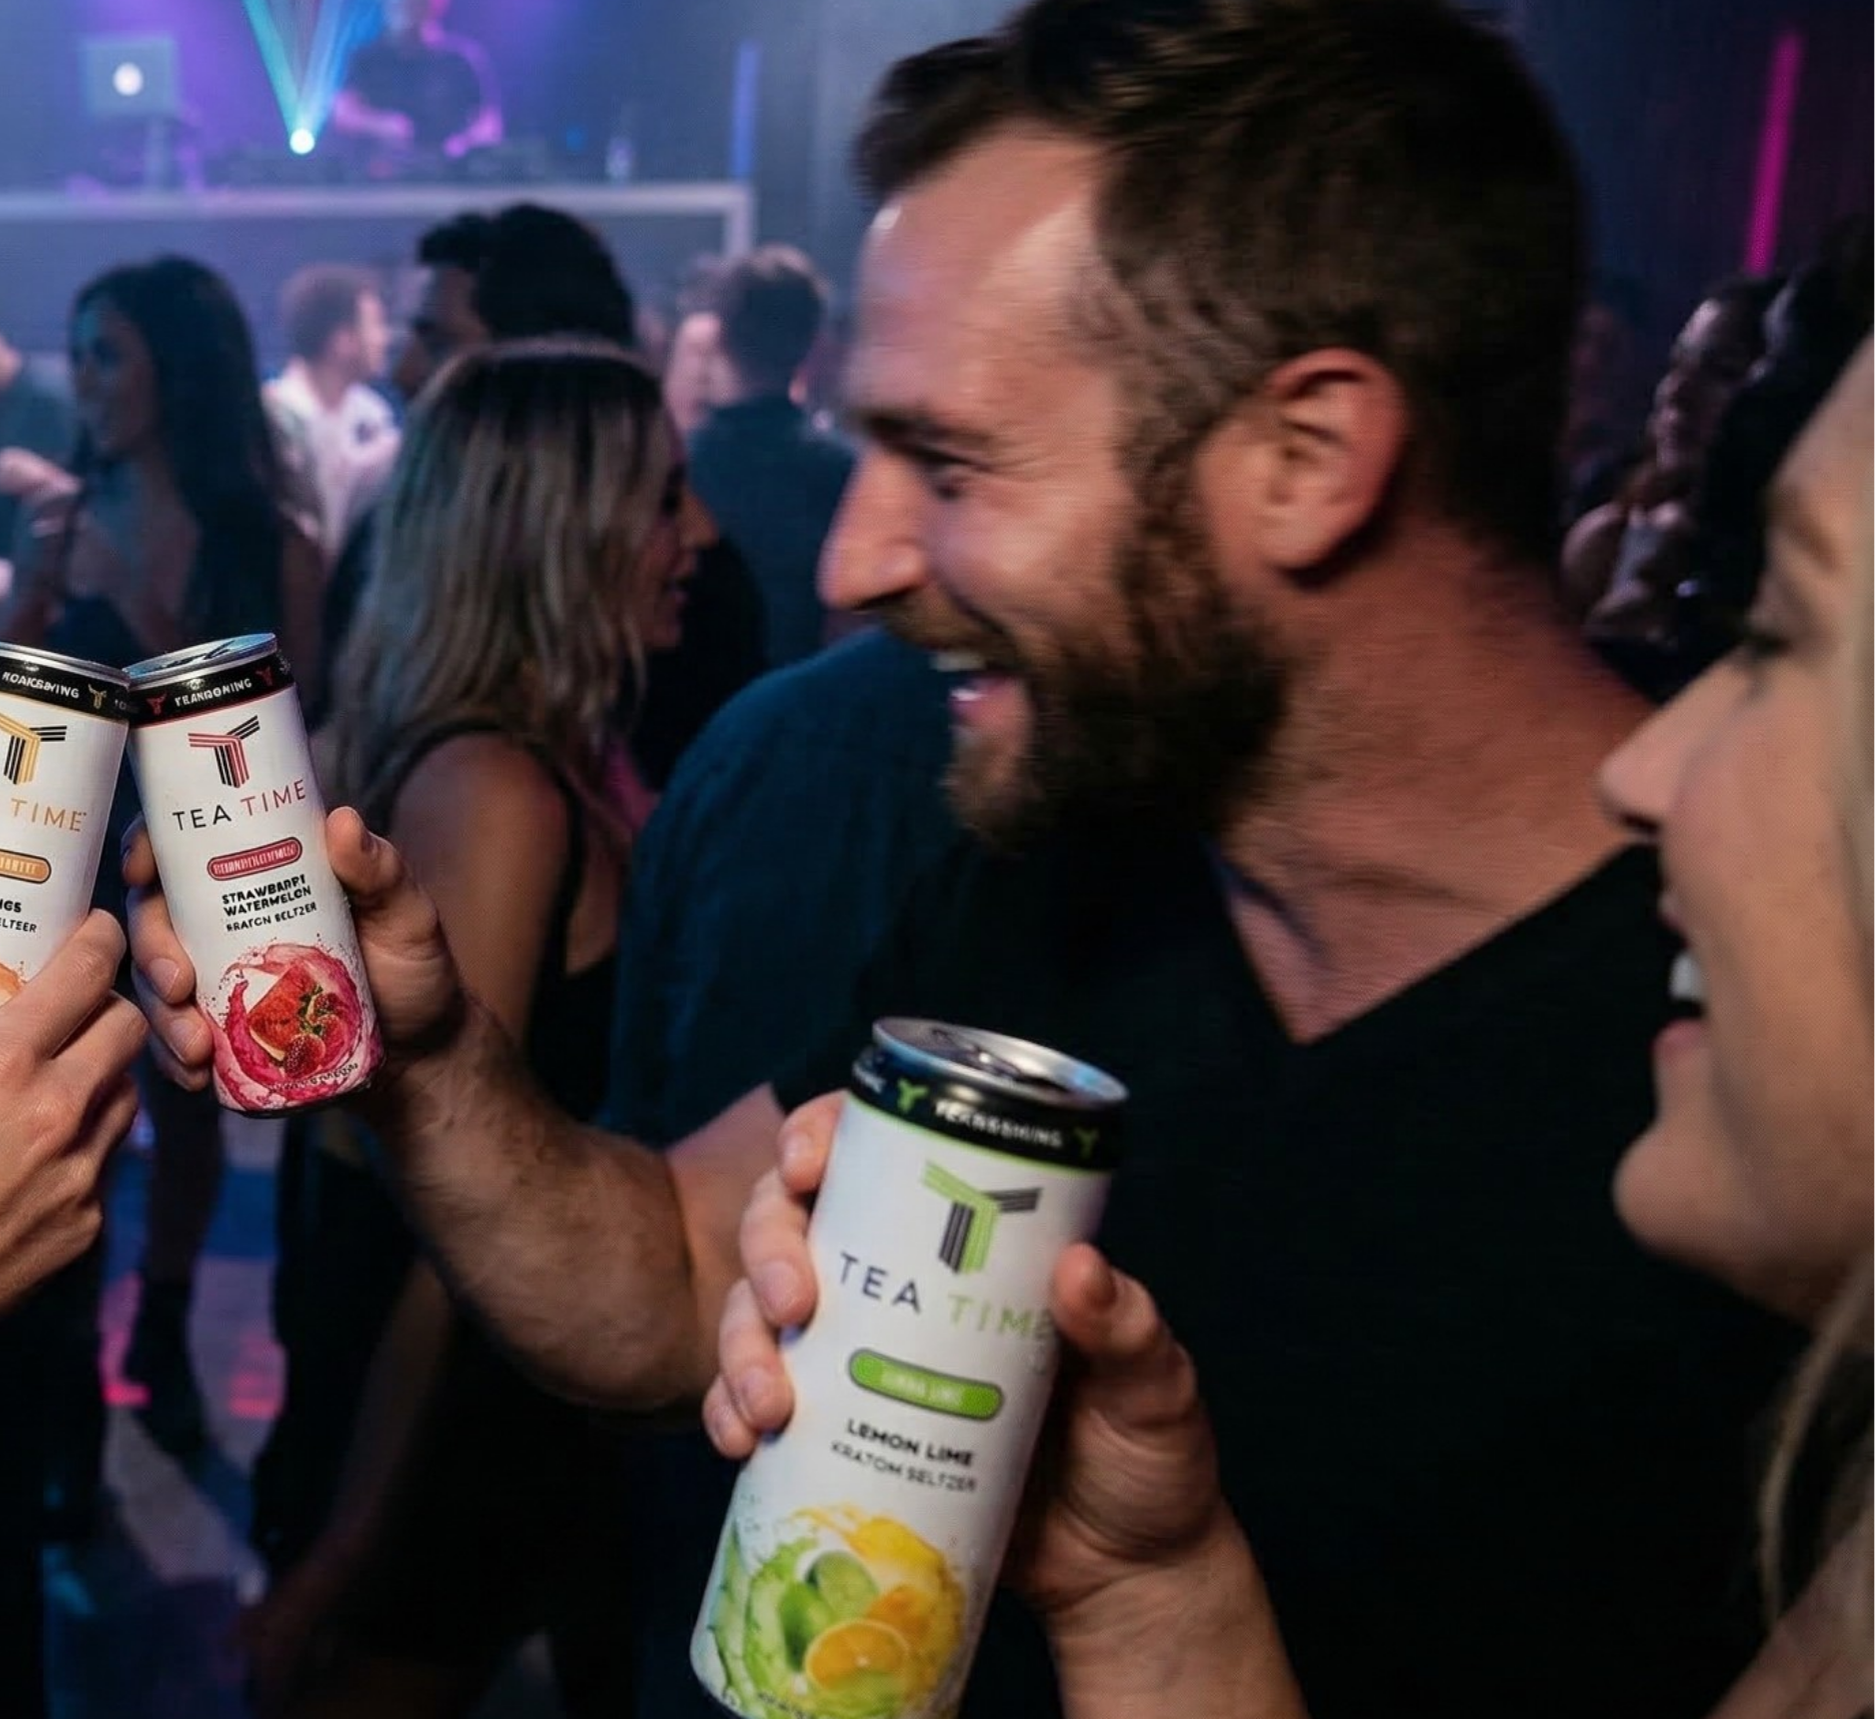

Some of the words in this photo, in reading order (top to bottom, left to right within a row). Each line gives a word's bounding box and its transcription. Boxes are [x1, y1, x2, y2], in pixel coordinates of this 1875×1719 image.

[10, 797, 82, 832] TIME
[172, 804, 232, 831] TEA
[240, 779, 306, 816] TIME
[840, 1251, 921, 1314] TEA
[949, 1292, 1054, 1340] TIME
[847, 1418, 920, 1455] LEMON
